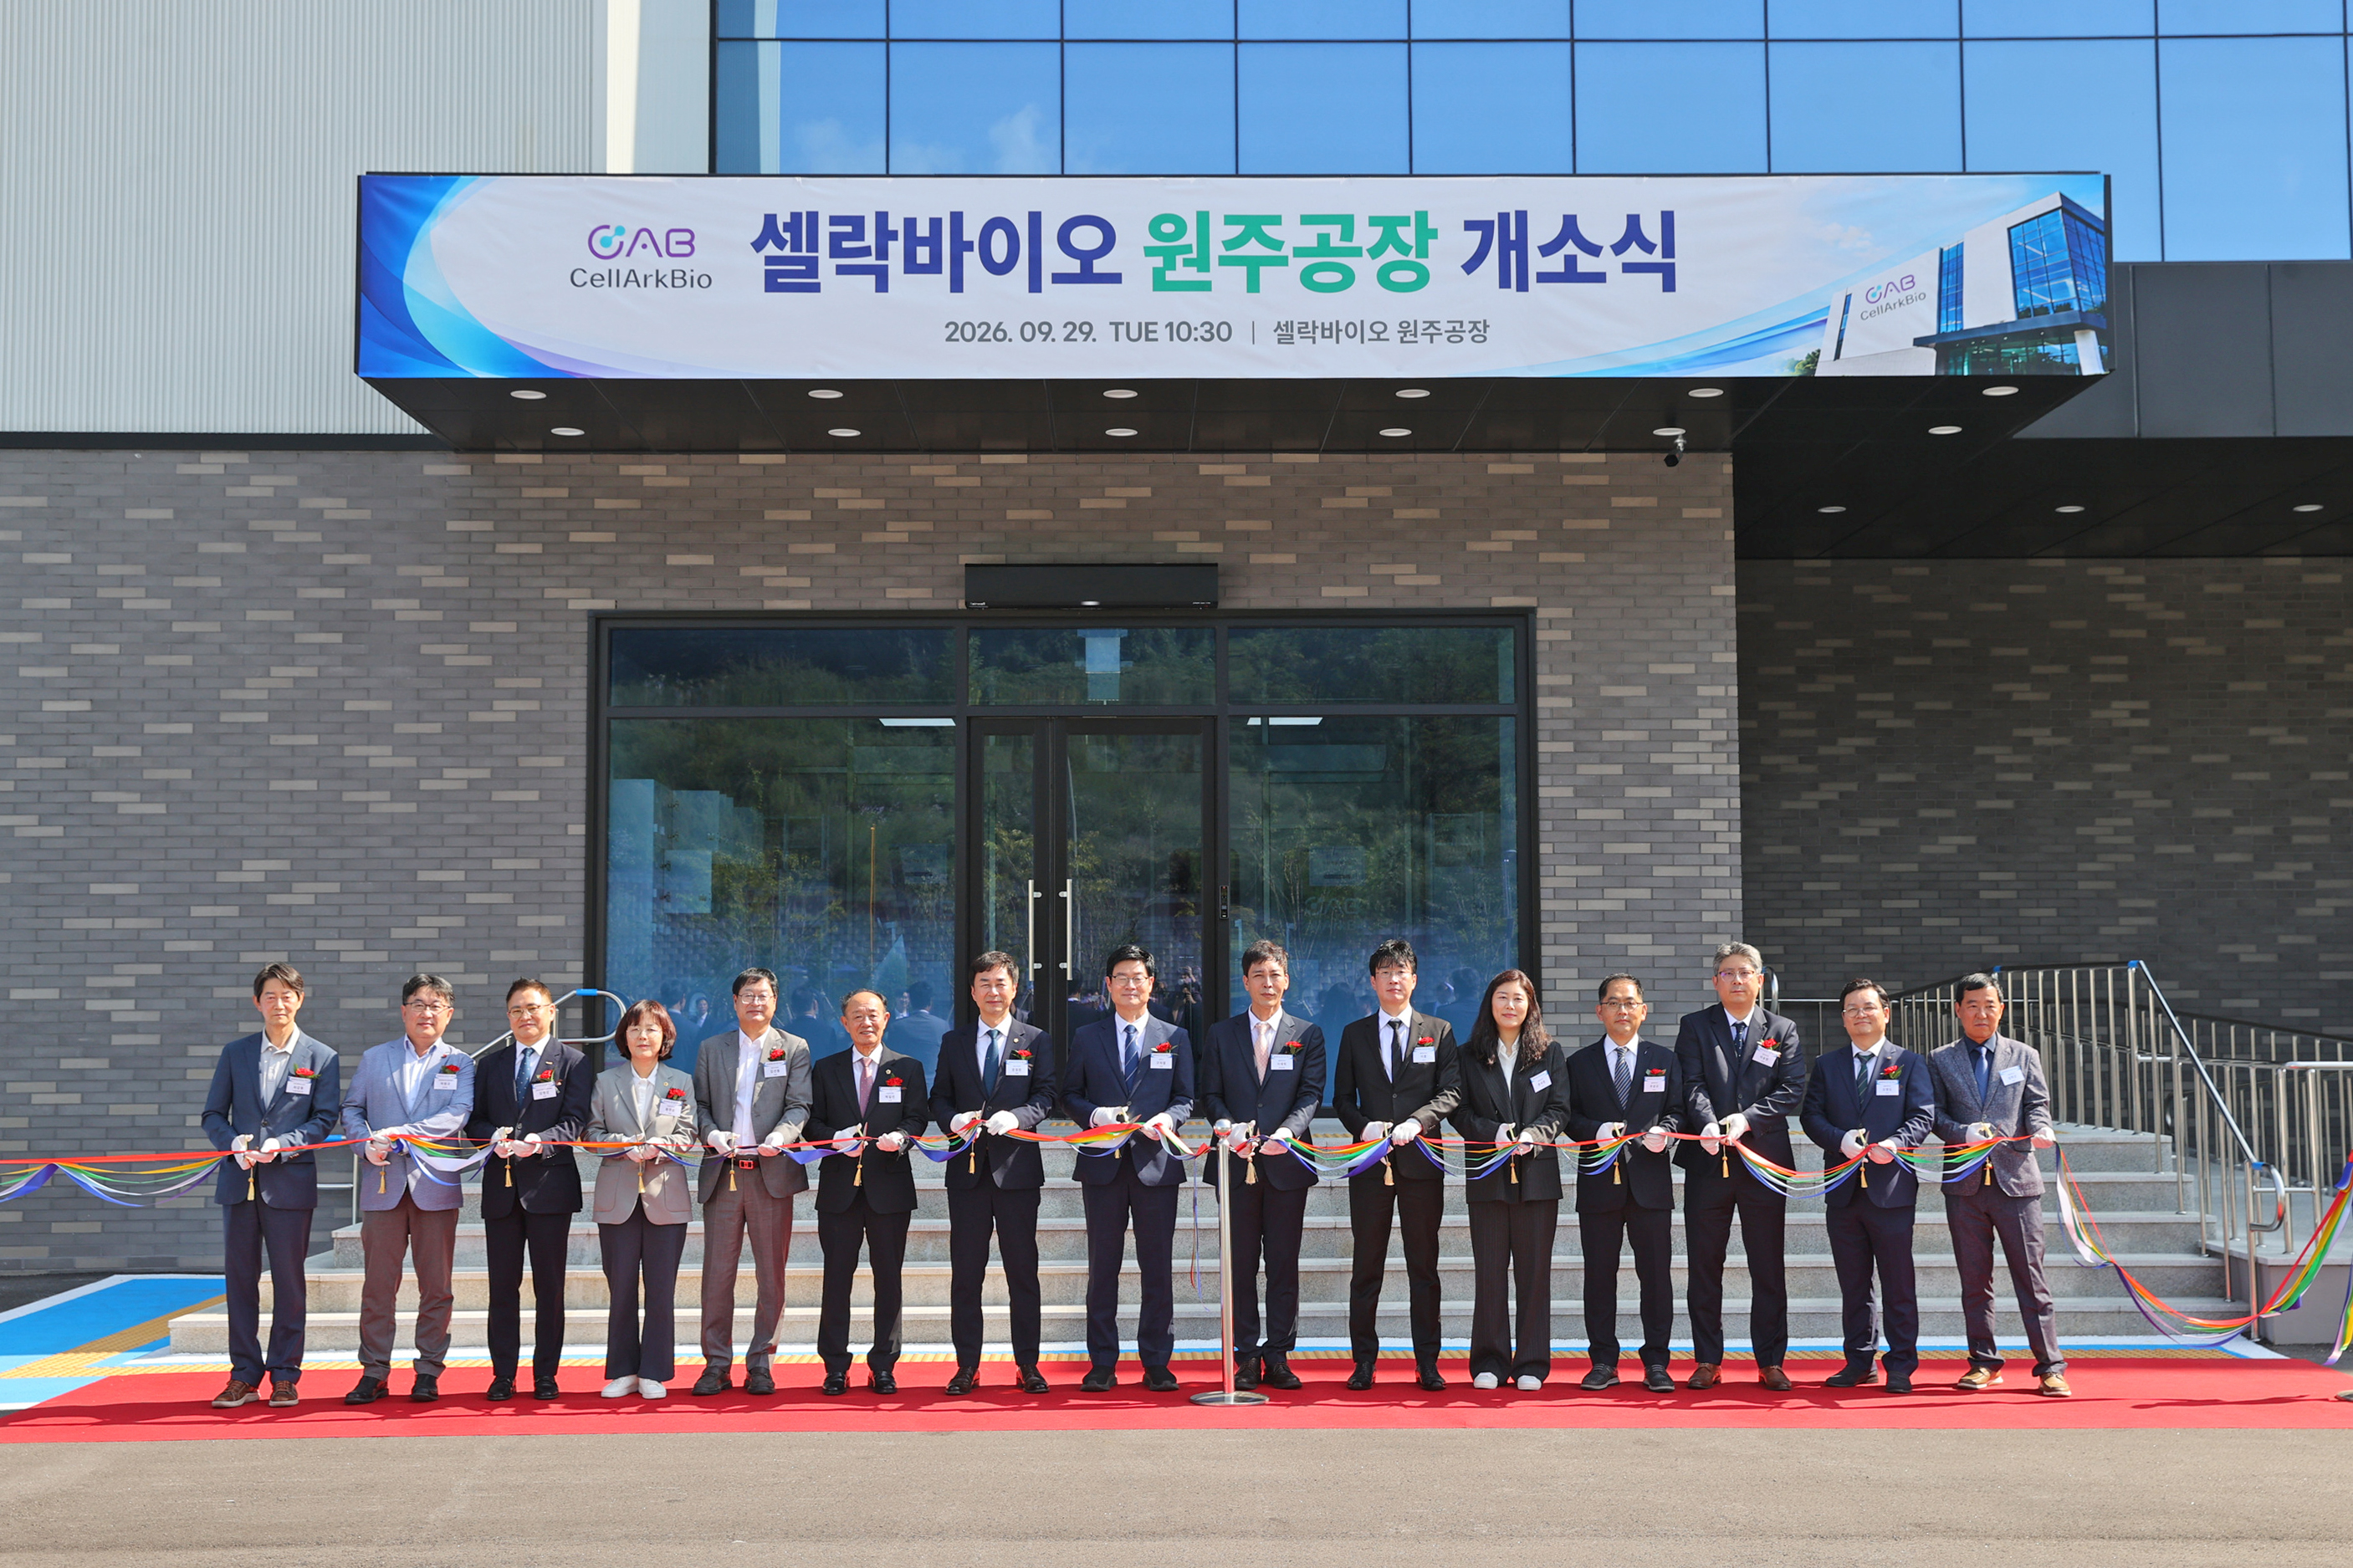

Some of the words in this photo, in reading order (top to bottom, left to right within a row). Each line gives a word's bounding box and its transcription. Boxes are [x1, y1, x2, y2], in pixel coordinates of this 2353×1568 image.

[750, 211, 1123, 294] 셀락바이오
[1143, 211, 1439, 294] 원주공장
[1460, 210, 1676, 293] 개소식
[570, 268, 713, 289] CellArkBio
[1860, 292, 1926, 320] CellArkBio
[944, 320, 1013, 343] 2026.
[1020, 320, 1056, 343] 09.
[1062, 320, 1097, 343] 29.
[1109, 321, 1159, 343] TUE
[1164, 321, 1233, 343] 10:30
[1273, 319, 1390, 345] 셀락바이오
[1397, 319, 1491, 345] 원주공장
